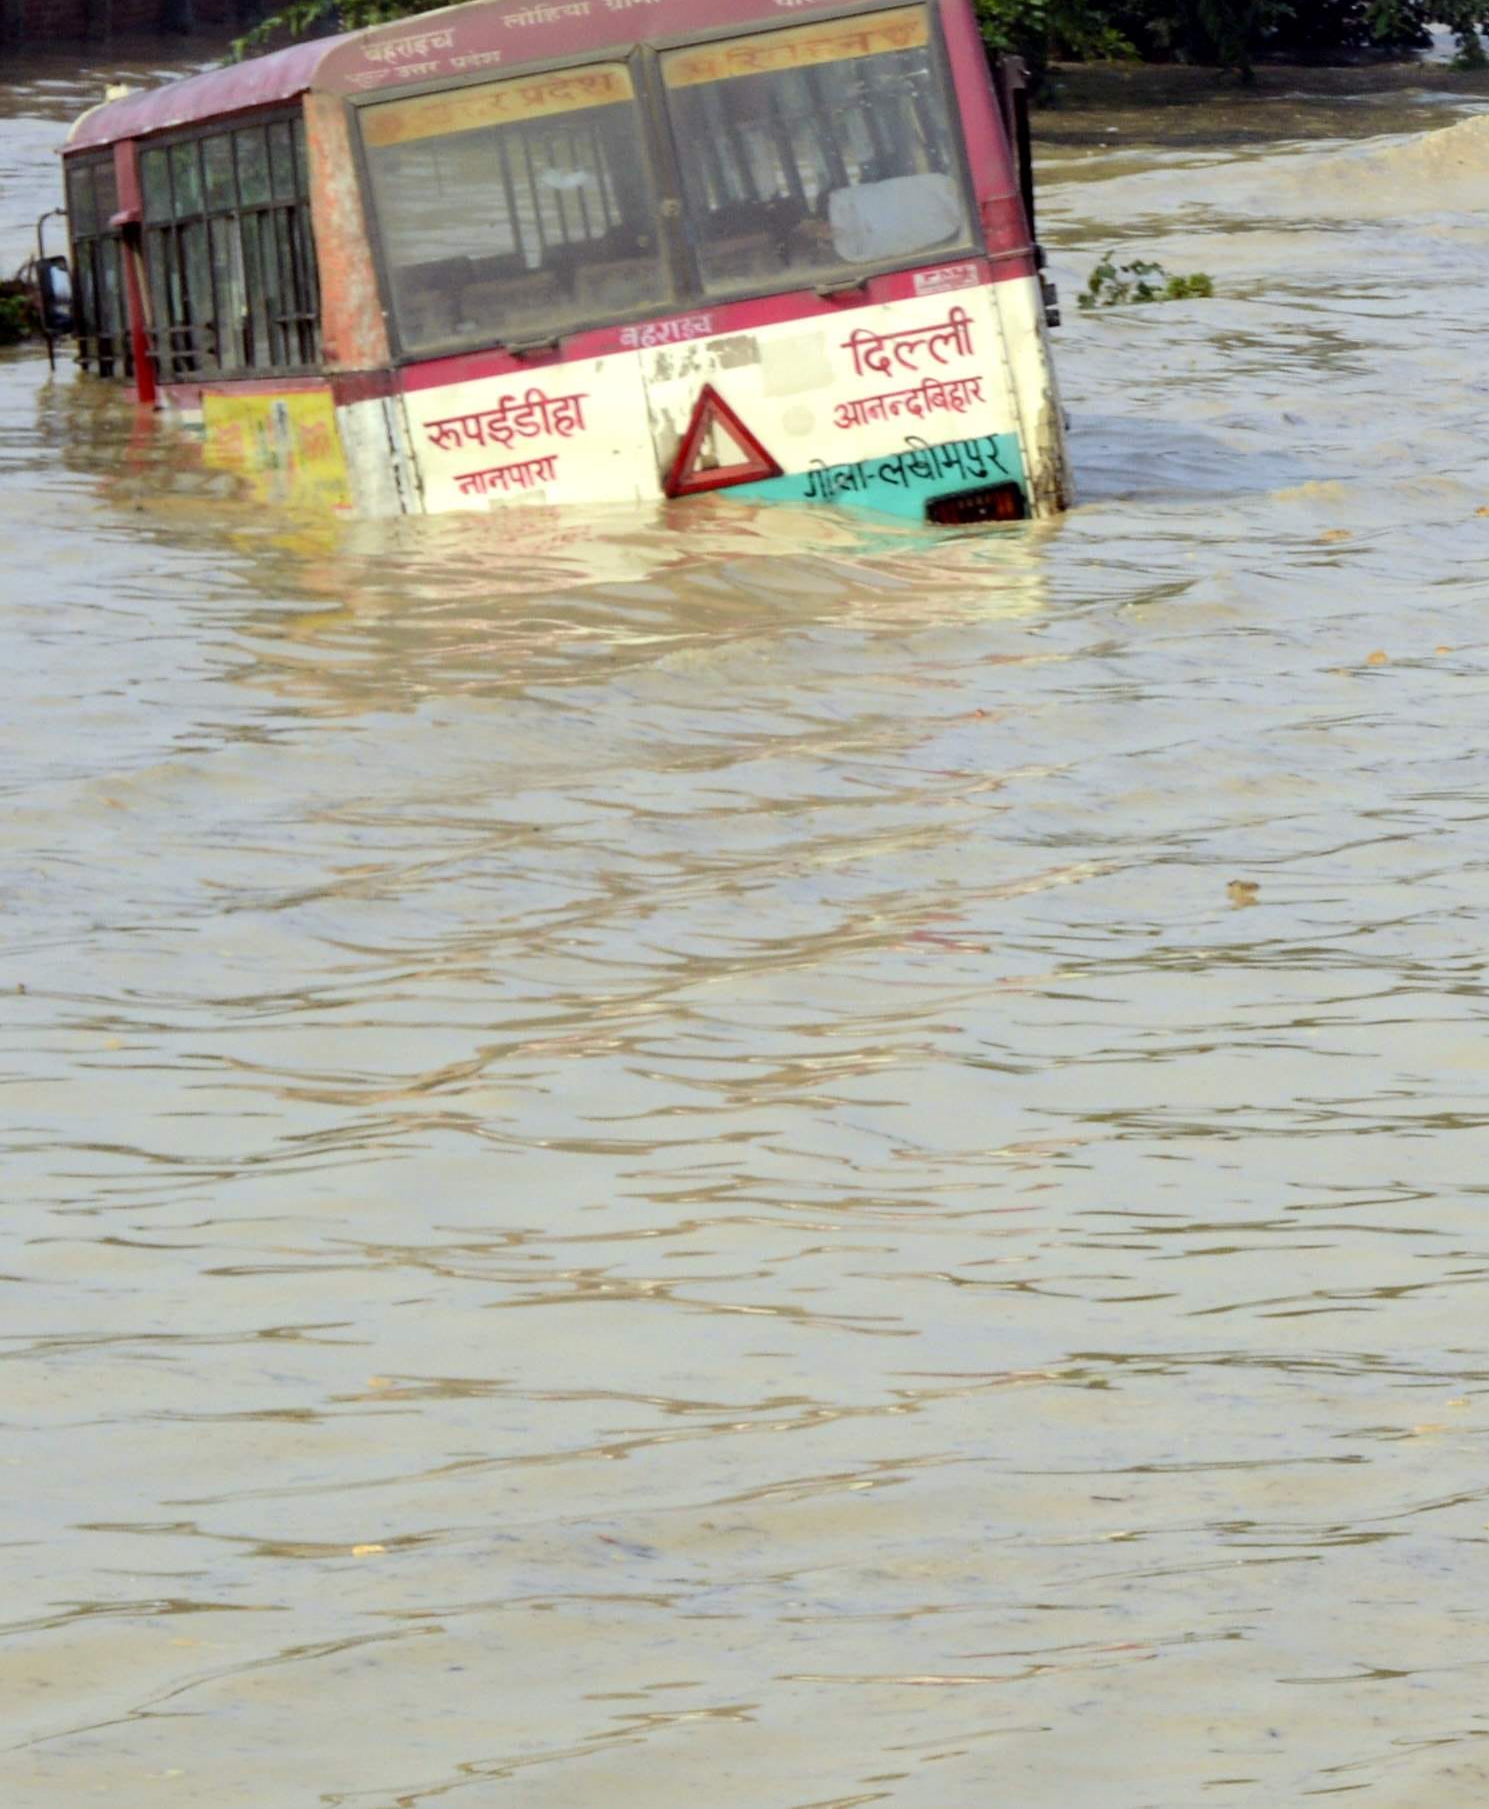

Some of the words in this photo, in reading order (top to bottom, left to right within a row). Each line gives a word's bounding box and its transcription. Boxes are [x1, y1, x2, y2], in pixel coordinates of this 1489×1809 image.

[500, 1, 592, 30] लोहिया
[392, 59, 440, 79] उत्तर
[840, 305, 975, 377] दिल्ली
[423, 387, 589, 452] रूपईडीहा
[453, 454, 559, 495] नानपारा
